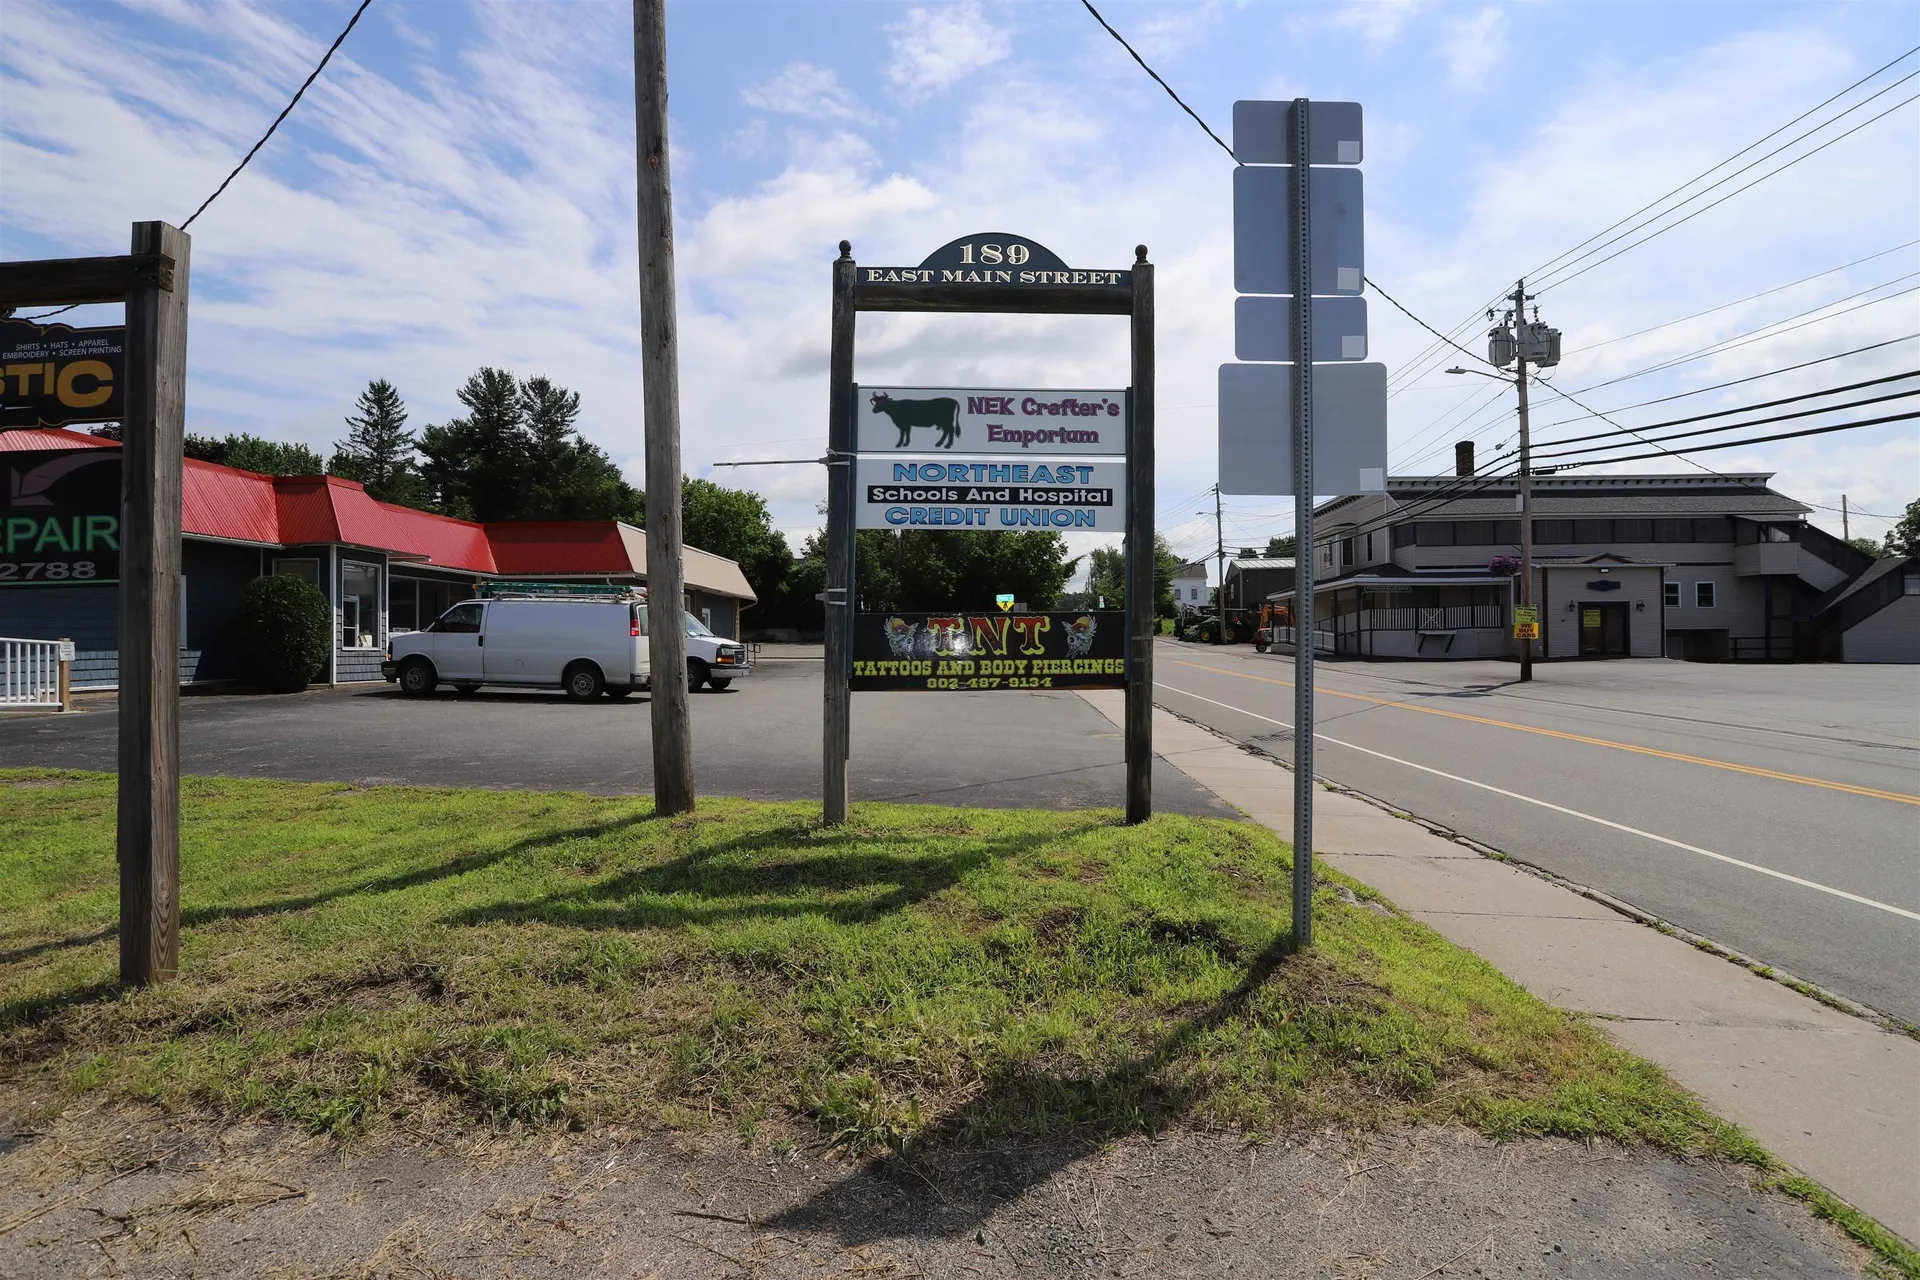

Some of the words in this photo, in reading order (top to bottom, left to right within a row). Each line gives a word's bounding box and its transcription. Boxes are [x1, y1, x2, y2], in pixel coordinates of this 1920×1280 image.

[960, 243, 1029, 265] 189
[866, 269, 934, 282] EAST
[941, 270, 1013, 283] MAIN
[1019, 270, 1121, 284] STREET
[2, 350, 50, 359] EMBROIDERY
[59, 348, 87, 356] SCREEN
[88, 346, 122, 355] PRINTING
[16, 343, 40, 351] SHIRTS
[50, 341, 69, 349] HATS
[78, 339, 109, 347] APPAREL
[0, 360, 114, 408] TIC
[967, 396, 1016, 415] NEK
[1021, 397, 1120, 417] Crafter's
[986, 423, 1100, 448] Emporium
[893, 463, 1094, 484] NORTHEAST
[872, 488, 959, 501] Schools
[965, 488, 1009, 501] And
[1020, 488, 1108, 504] Hospital
[885, 506, 991, 525] CREDIT
[1000, 507, 1096, 527] UNION
[0, 515, 120, 553] PAIR
[926, 616, 1051, 656] TNT
[853, 660, 932, 676] TATTOOS
[936, 660, 975, 676] AND
[980, 660, 1028, 675] BODY
[1032, 659, 1125, 675] PIERCINGS
[927, 677, 1053, 689] 802-487-9134
